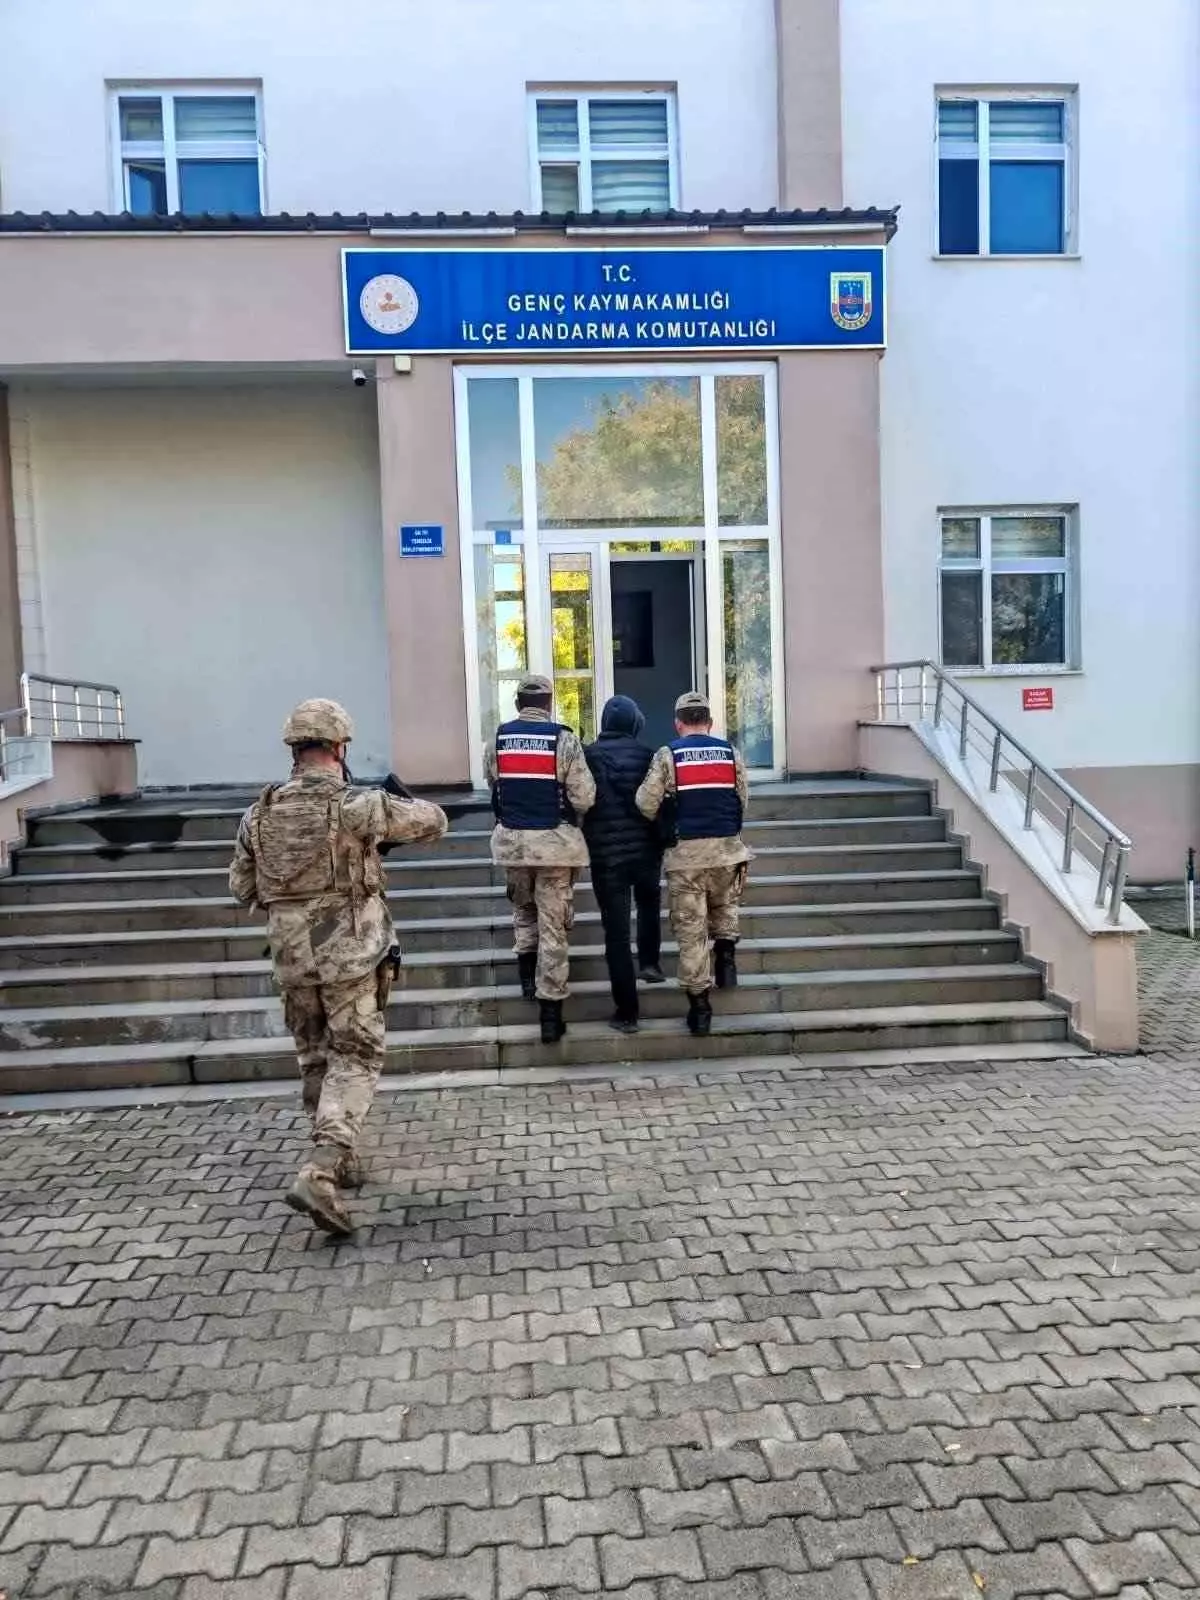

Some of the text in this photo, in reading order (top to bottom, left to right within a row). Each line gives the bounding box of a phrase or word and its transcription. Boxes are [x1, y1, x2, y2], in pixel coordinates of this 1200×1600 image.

[602, 265, 636, 282] T.C.
[508, 291, 730, 314] GENÇ KAYMAKAMLIĞI
[462, 319, 776, 344] İLÇE JANDARMA KOMUTANLIĞI
[502, 738, 549, 751] JANDARMA
[681, 750, 727, 762] JANDARMA
